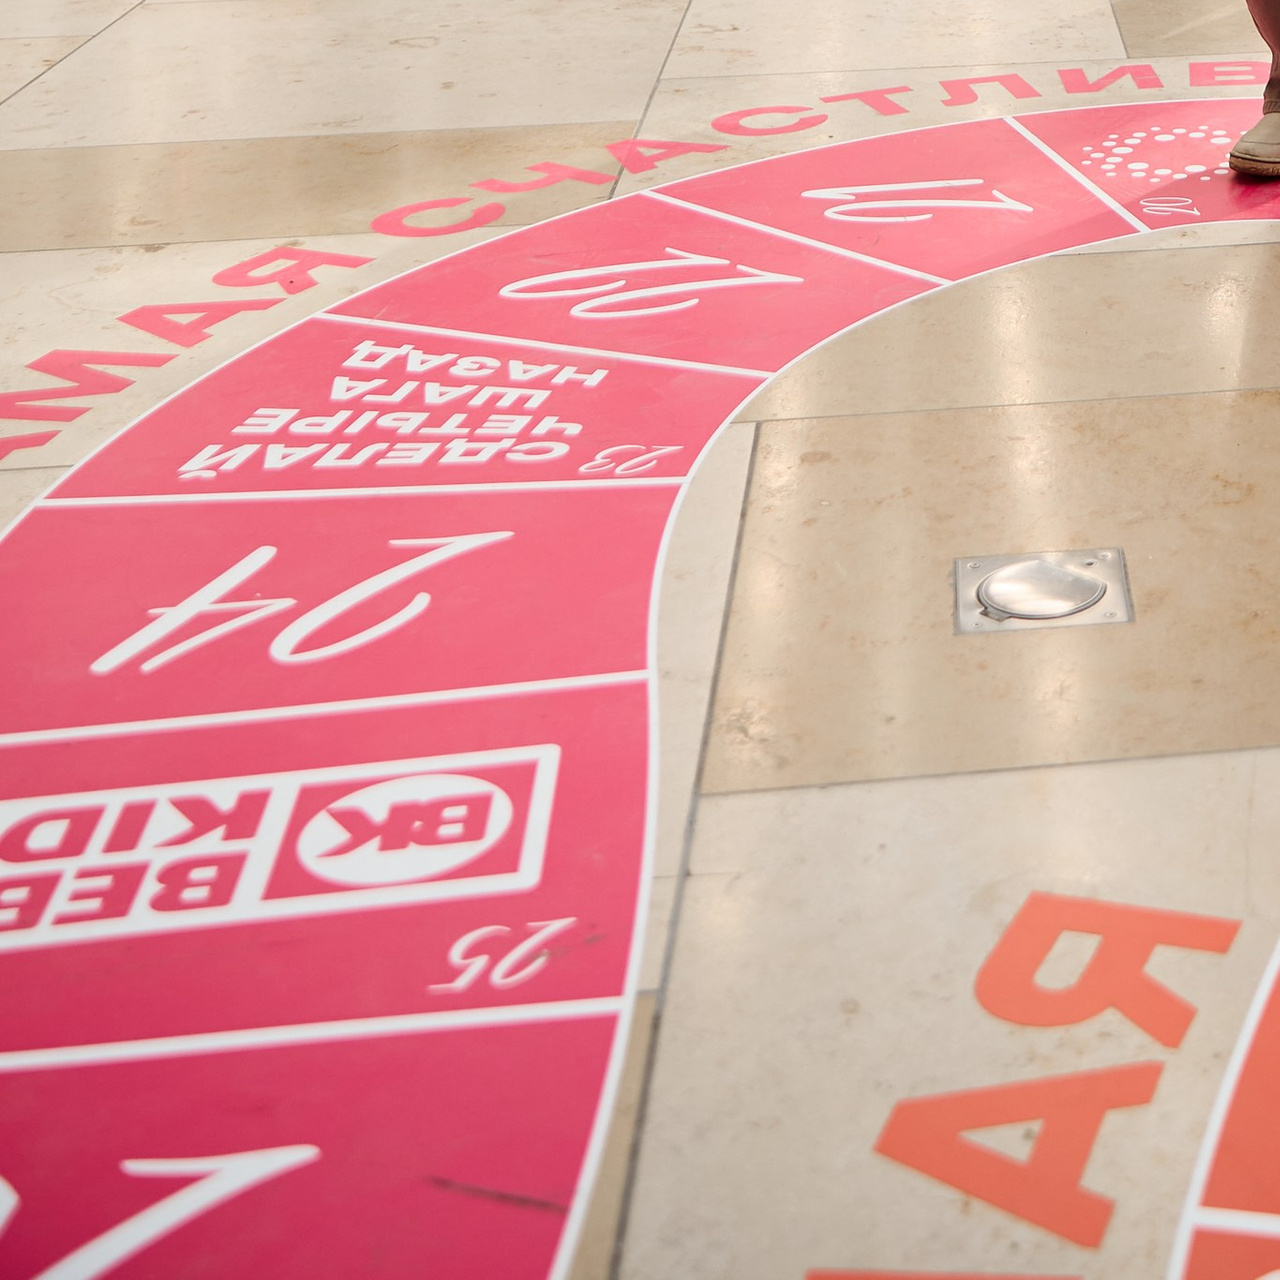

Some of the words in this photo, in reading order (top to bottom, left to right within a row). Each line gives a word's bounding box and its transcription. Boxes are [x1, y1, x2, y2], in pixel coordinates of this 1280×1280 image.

[801, 178, 1034, 223] 21
[1139, 196, 1201, 216] 20
[498, 246, 804, 319] 22
[342, 340, 610, 387] НАЗАД
[330, 375, 553, 408] ШАГА
[231, 407, 584, 436] ЧЕТЫРЕ
[178, 438, 572, 478] СДЕЛАЙ
[578, 444, 684, 474] 23
[90, 531, 515, 675] 24
[315, 790, 496, 860] BK
[426, 915, 578, 994] 25
[803, 888, 1243, 1280] АЯ
